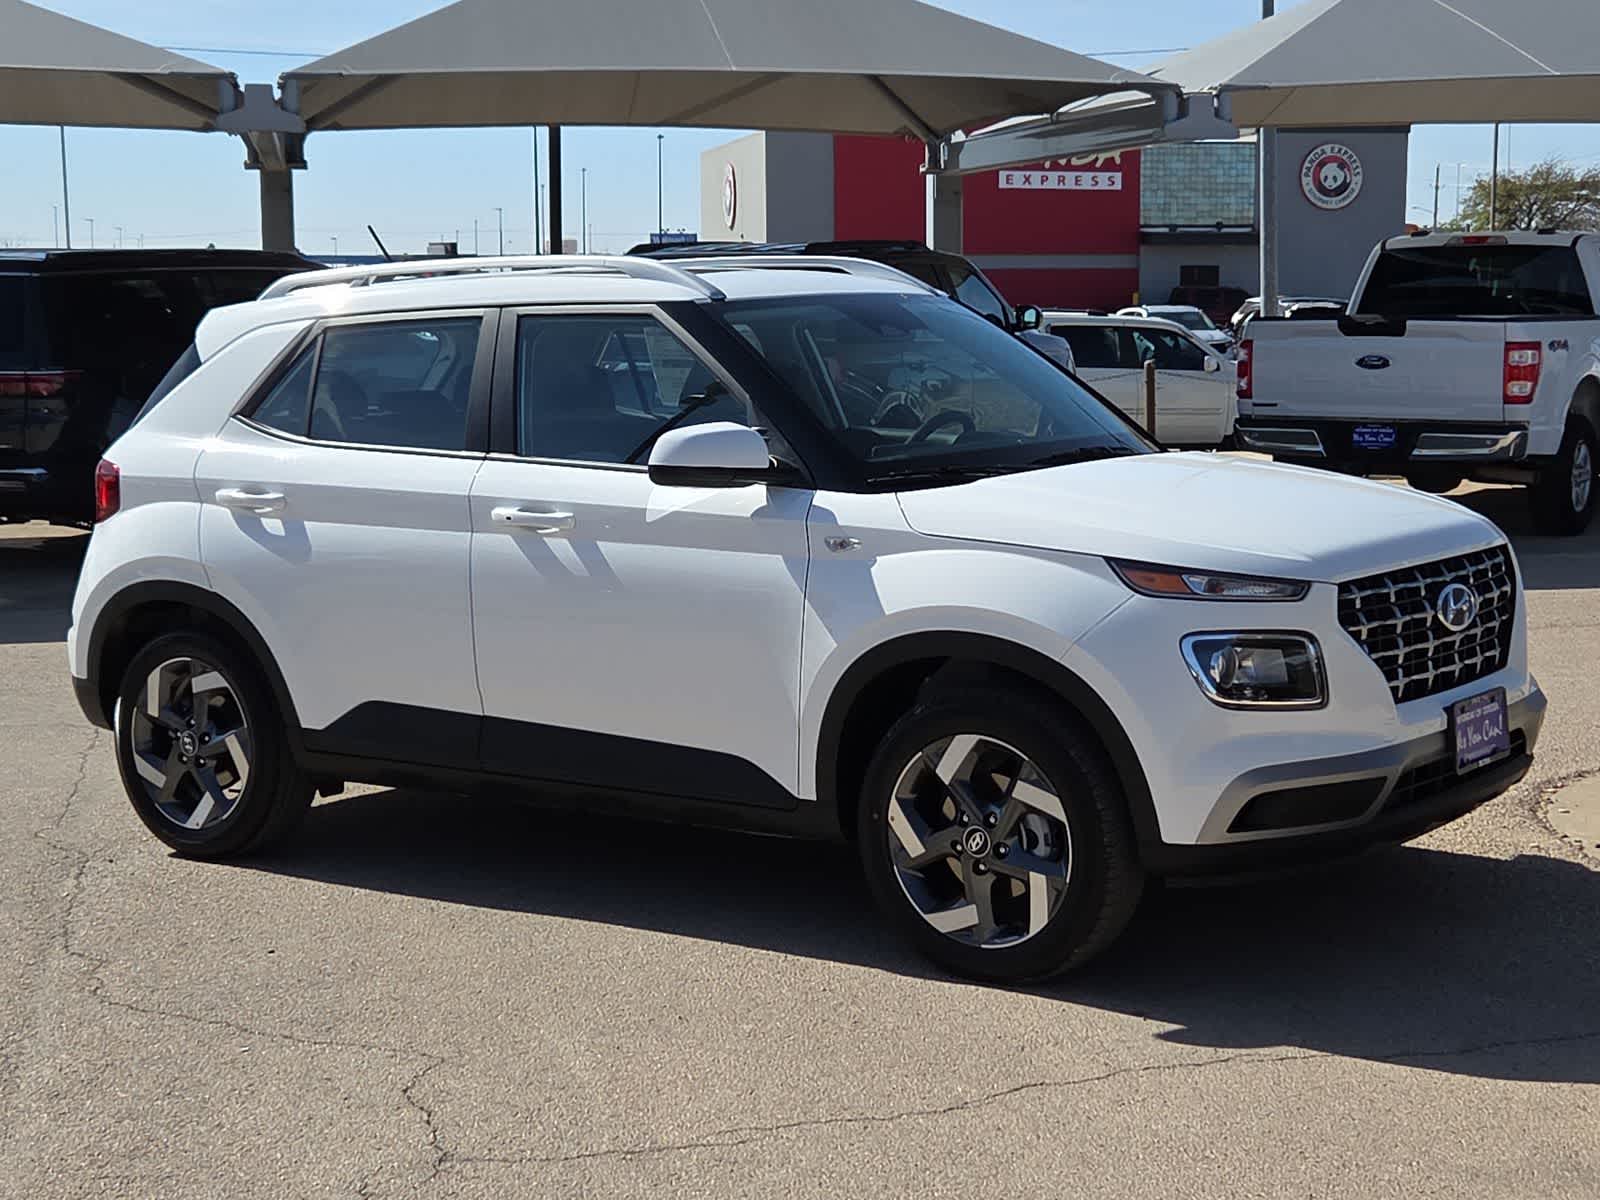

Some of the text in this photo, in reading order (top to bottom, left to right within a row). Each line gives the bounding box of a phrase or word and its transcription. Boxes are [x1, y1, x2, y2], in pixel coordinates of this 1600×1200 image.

[1303, 146, 1360, 178] PANDA EXPRESS
[1005, 174, 1116, 187] EXPRESS
[1467, 724, 1482, 747] You
